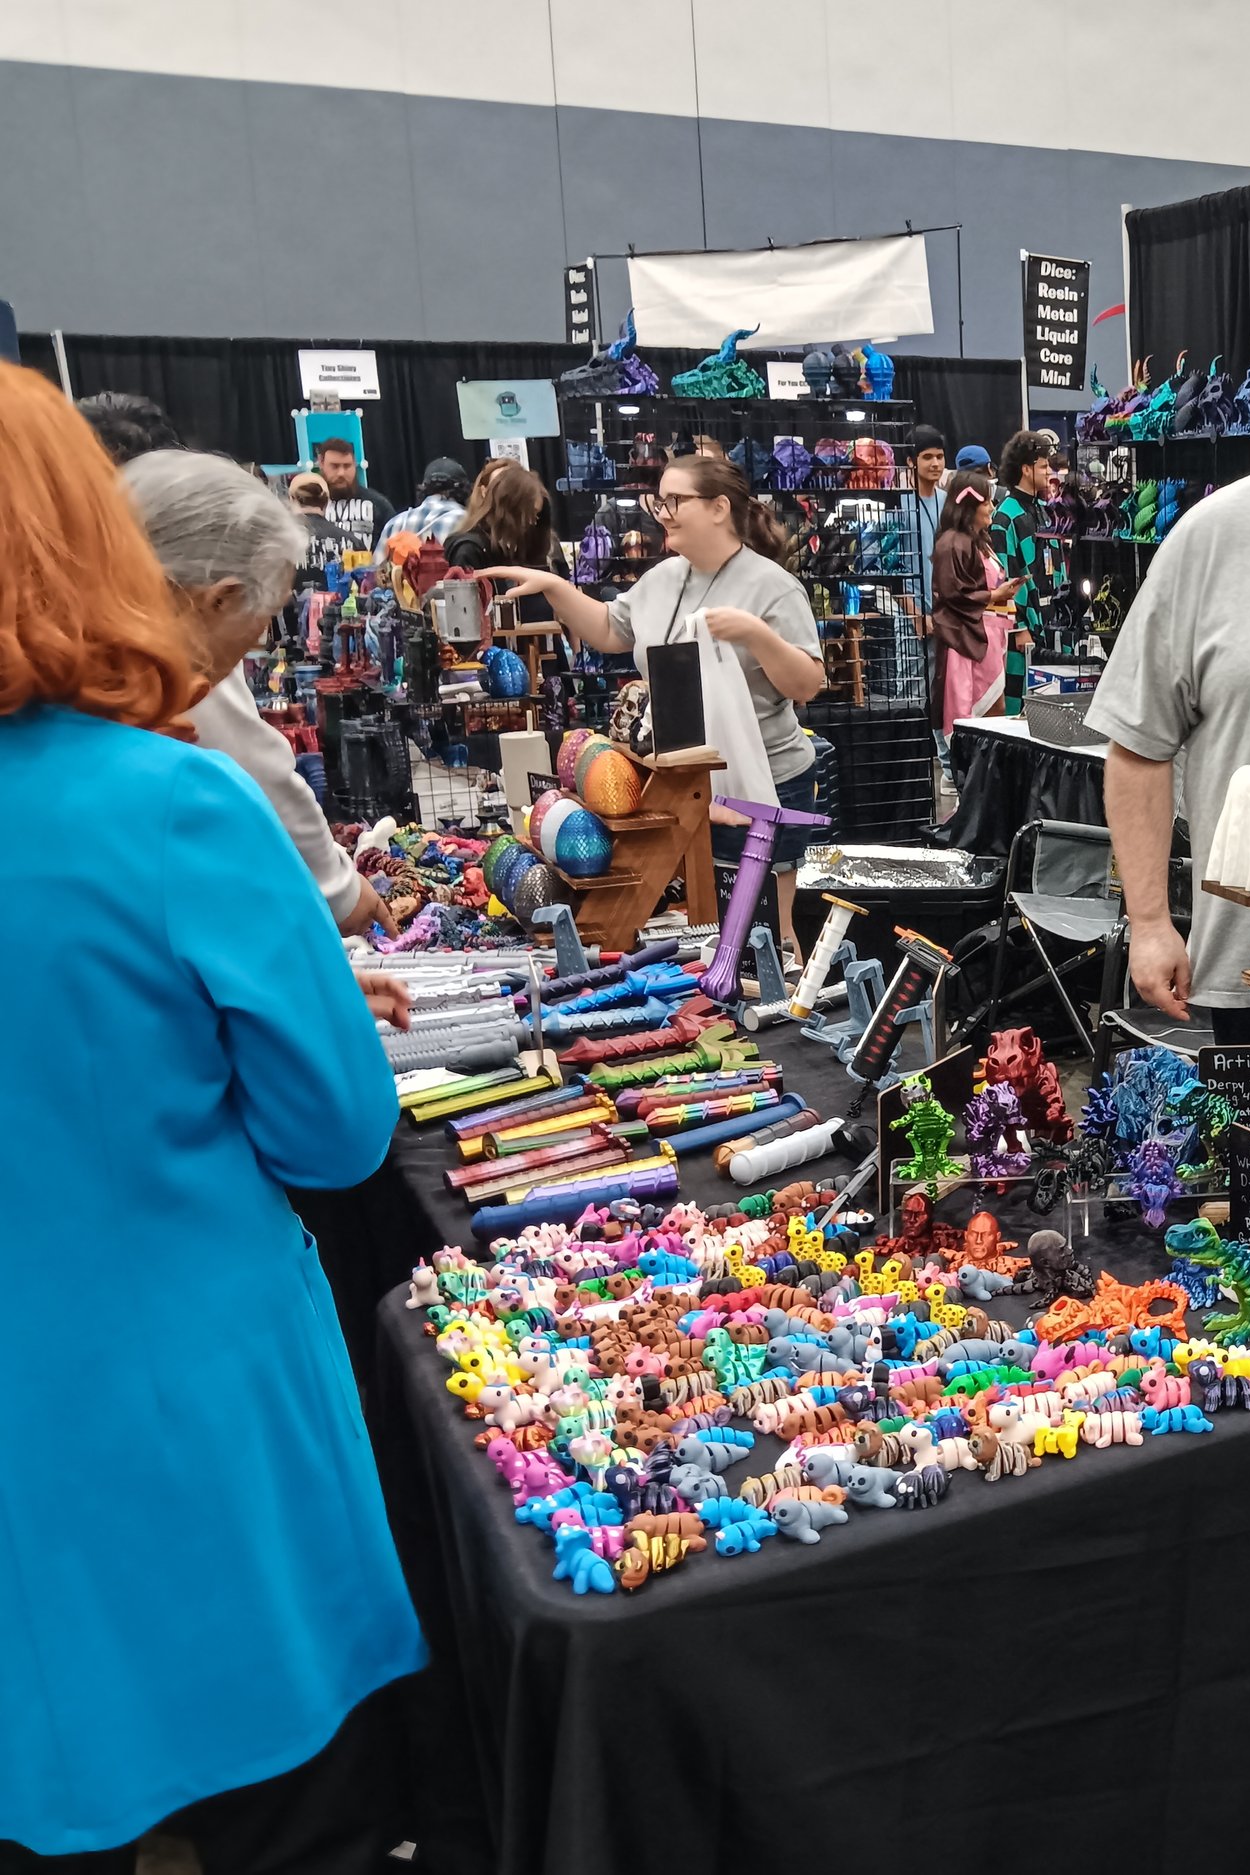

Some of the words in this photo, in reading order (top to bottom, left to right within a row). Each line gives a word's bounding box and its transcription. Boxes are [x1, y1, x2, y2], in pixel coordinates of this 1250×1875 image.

[1041, 261, 1076, 280] Dice:
[1038, 282, 1078, 301] Resin
[1037, 304, 1078, 322] Metal
[1036, 326, 1078, 345] Liquid
[1040, 348, 1073, 365] Core
[1040, 369, 1071, 386] Mini
[1207, 1079, 1245, 1094] Derpy
